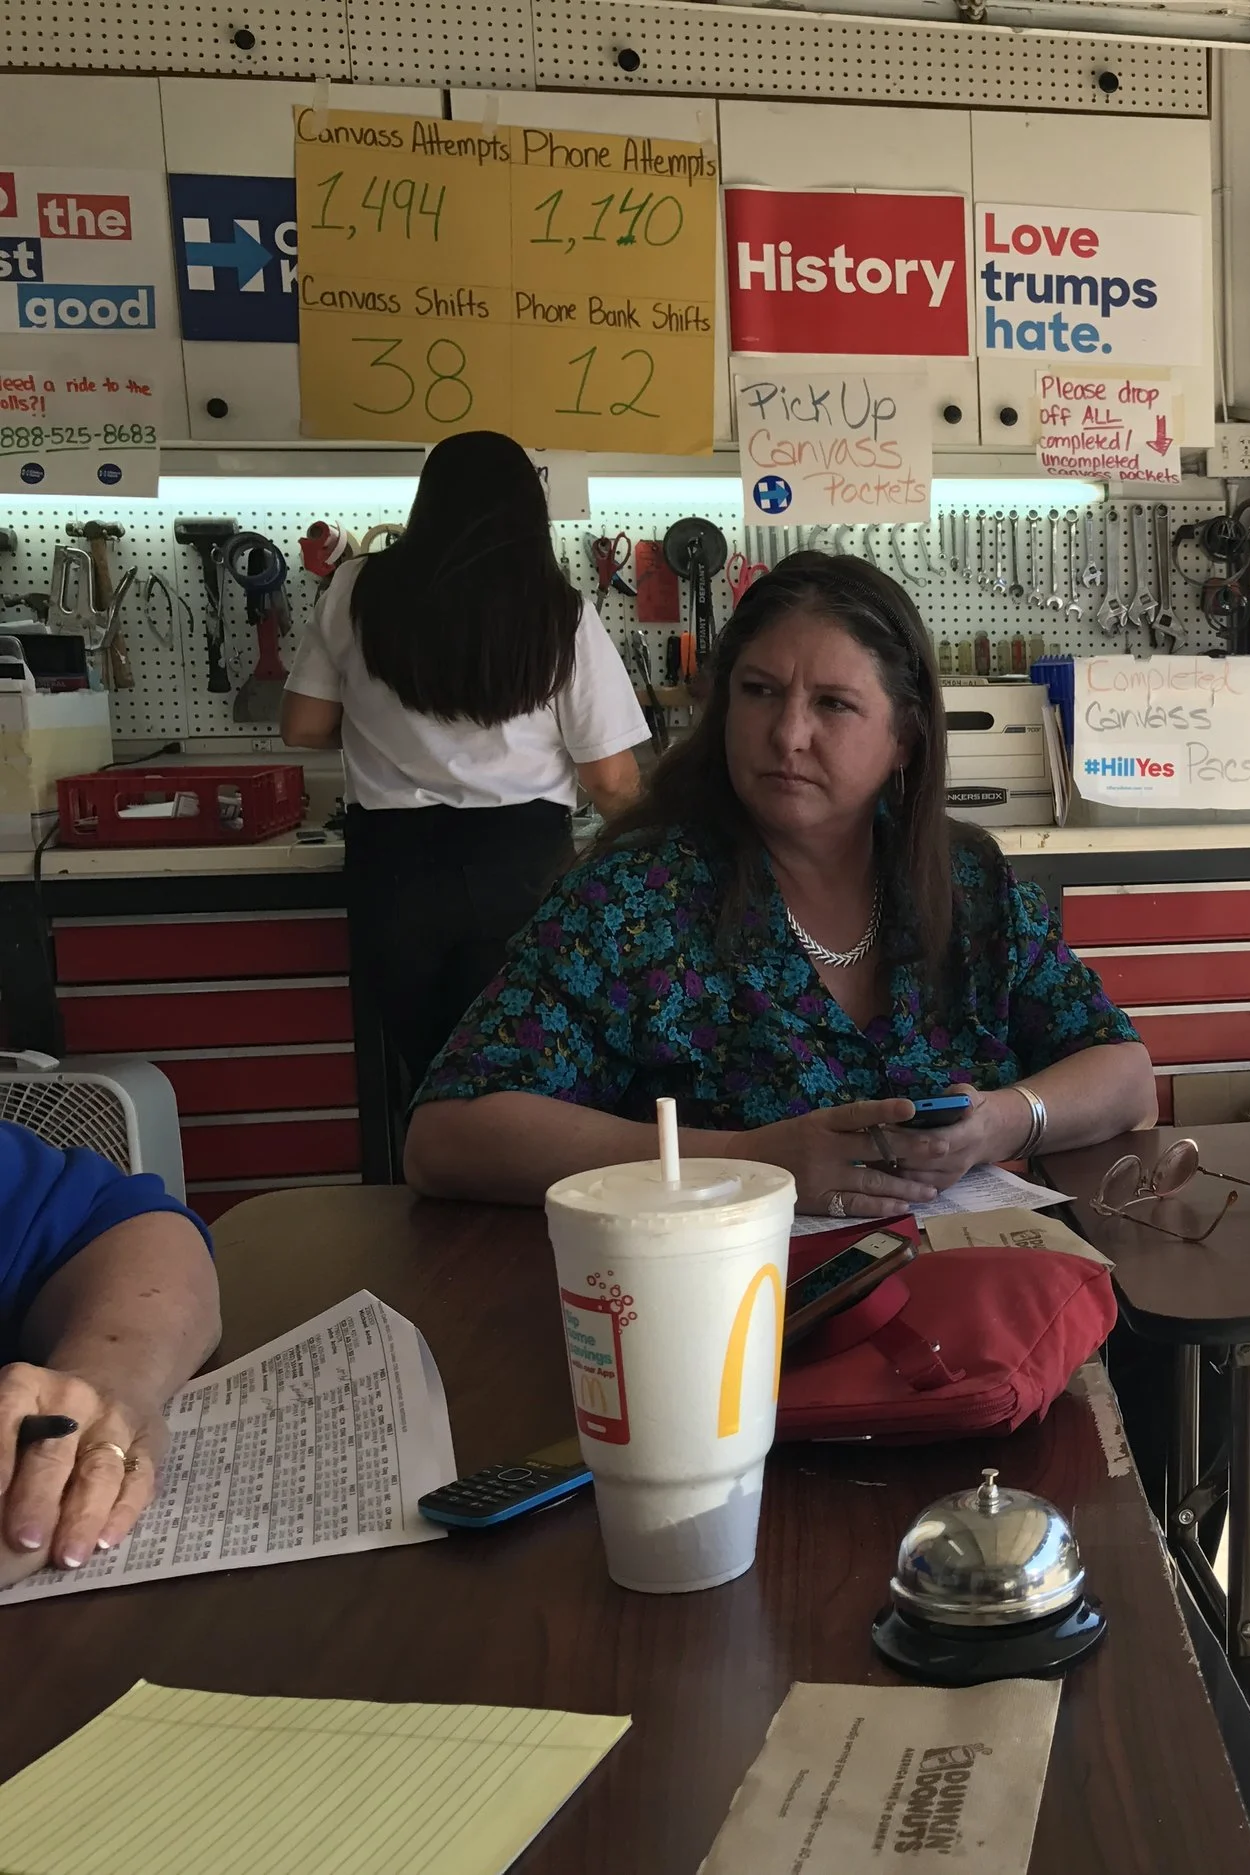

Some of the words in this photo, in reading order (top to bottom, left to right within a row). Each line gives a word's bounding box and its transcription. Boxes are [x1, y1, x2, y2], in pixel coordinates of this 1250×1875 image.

[297, 108, 403, 149] Canvass
[411, 120, 510, 166] Attempts
[523, 129, 612, 168] Phone
[623, 139, 717, 188] Attempts
[43, 198, 127, 238] the
[311, 170, 446, 242] 1,494
[984, 212, 1100, 258] Love
[737, 240, 955, 308] History
[980, 260, 1158, 318] trumps
[25, 288, 149, 328] good
[301, 275, 401, 314] Canvass
[415, 286, 489, 319] Shifts
[516, 291, 576, 324] Phone
[588, 297, 641, 329] Bank
[652, 302, 711, 333] Shifts
[985, 306, 1113, 355] hate.
[43, 380, 56, 393] a
[66, 376, 97, 393] ride
[102, 377, 120, 393] to
[125, 379, 152, 396] the
[352, 338, 473, 423] 38
[555, 346, 661, 418] 12
[1041, 375, 1106, 400] Please
[1118, 380, 1160, 411] drop
[740, 382, 832, 426] Pick
[840, 377, 897, 443] Up
[1040, 404, 1071, 426] off
[1081, 405, 1123, 426] ALL
[749, 428, 903, 470] Canvass
[1047, 467, 1112, 480] canvass
[698, 564, 706, 604] DEFIANT
[1087, 659, 1243, 703] Completed
[1085, 700, 1212, 732] Canvass
[1084, 756, 1175, 778] #HillYes
[947, 792, 981, 801] NKERS
[981, 792, 1003, 800] BOX
[896, 1748, 915, 1779] AMERICA
[894, 1773, 942, 1853] DONUTS
[925, 1770, 971, 1854] DUNKIN'
